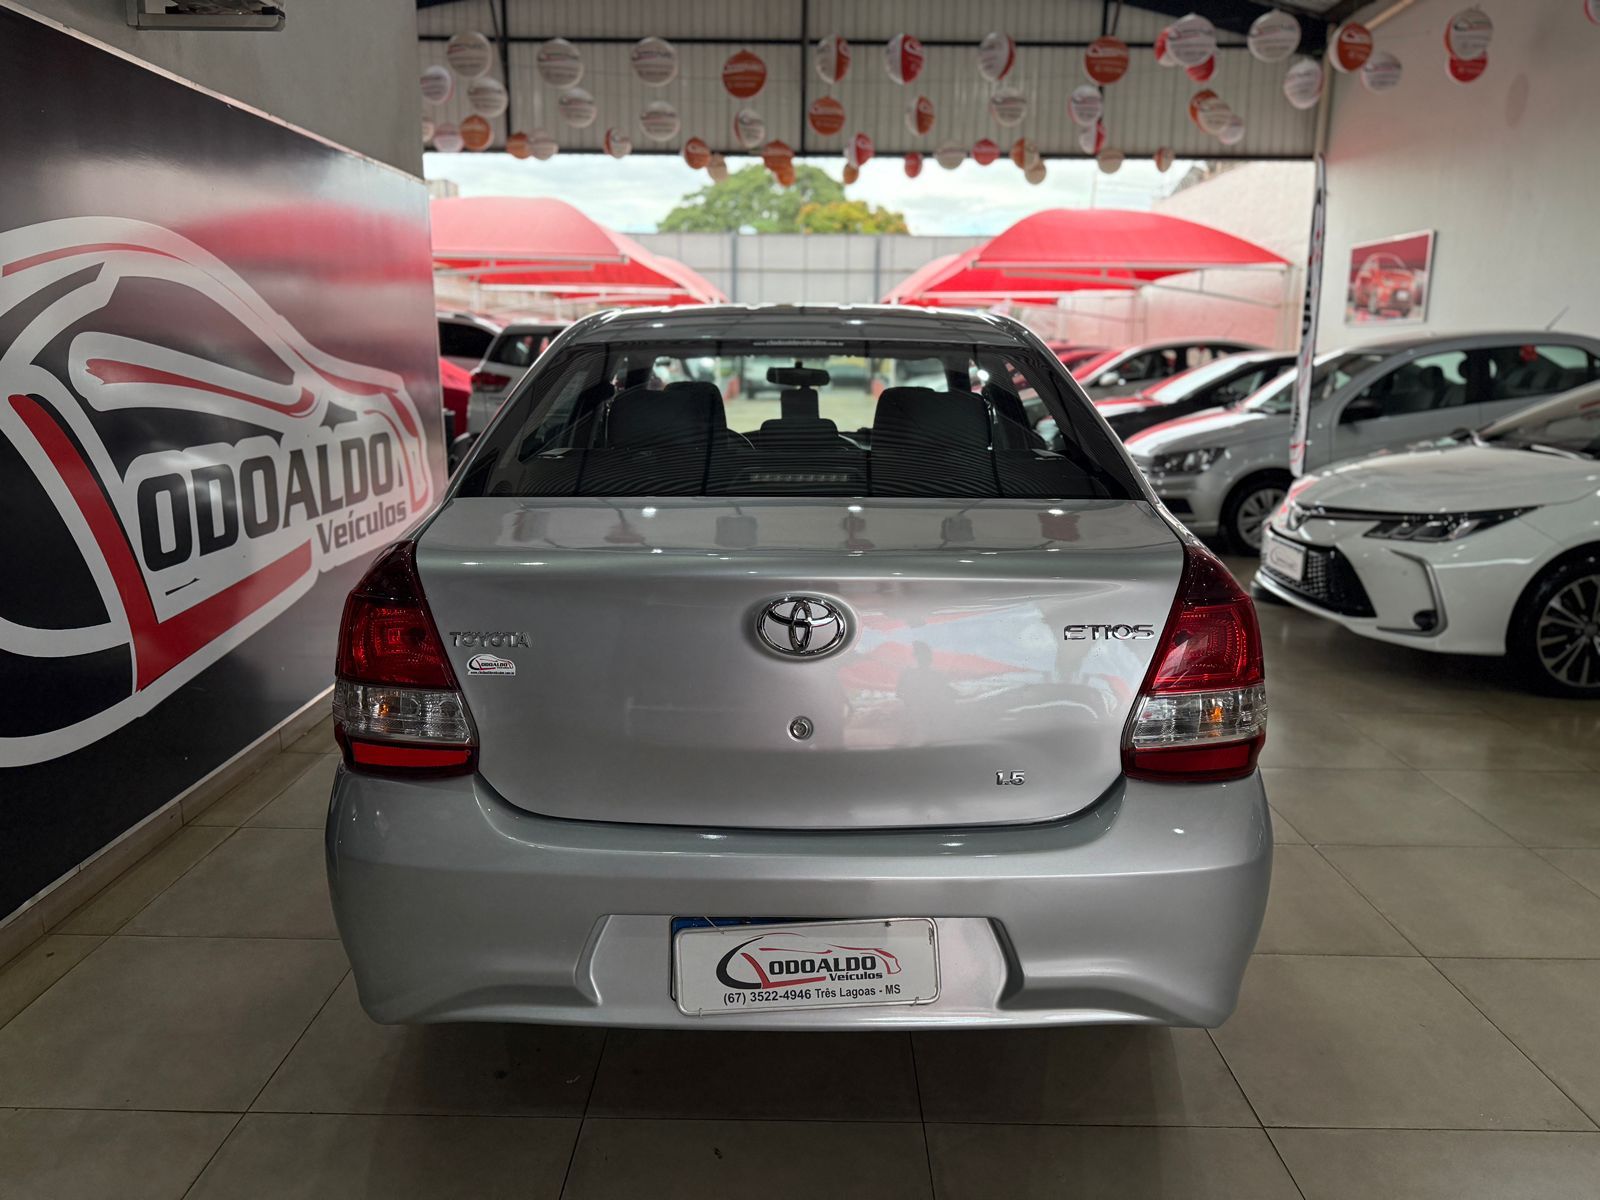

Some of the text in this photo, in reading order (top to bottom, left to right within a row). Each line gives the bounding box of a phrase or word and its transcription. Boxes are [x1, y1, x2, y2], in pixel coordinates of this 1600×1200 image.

[316, 500, 407, 554] Veículos
[449, 631, 531, 649] TOYOTA
[1063, 624, 1155, 641] ETIOS
[996, 769, 1025, 786] 1.5
[829, 971, 883, 982] Veículos
[723, 991, 746, 1005] (67)
[750, 989, 812, 1003] 3522-4946
[815, 988, 837, 999] Três
[839, 987, 877, 999] Lagoas
[885, 984, 901, 995] MS
